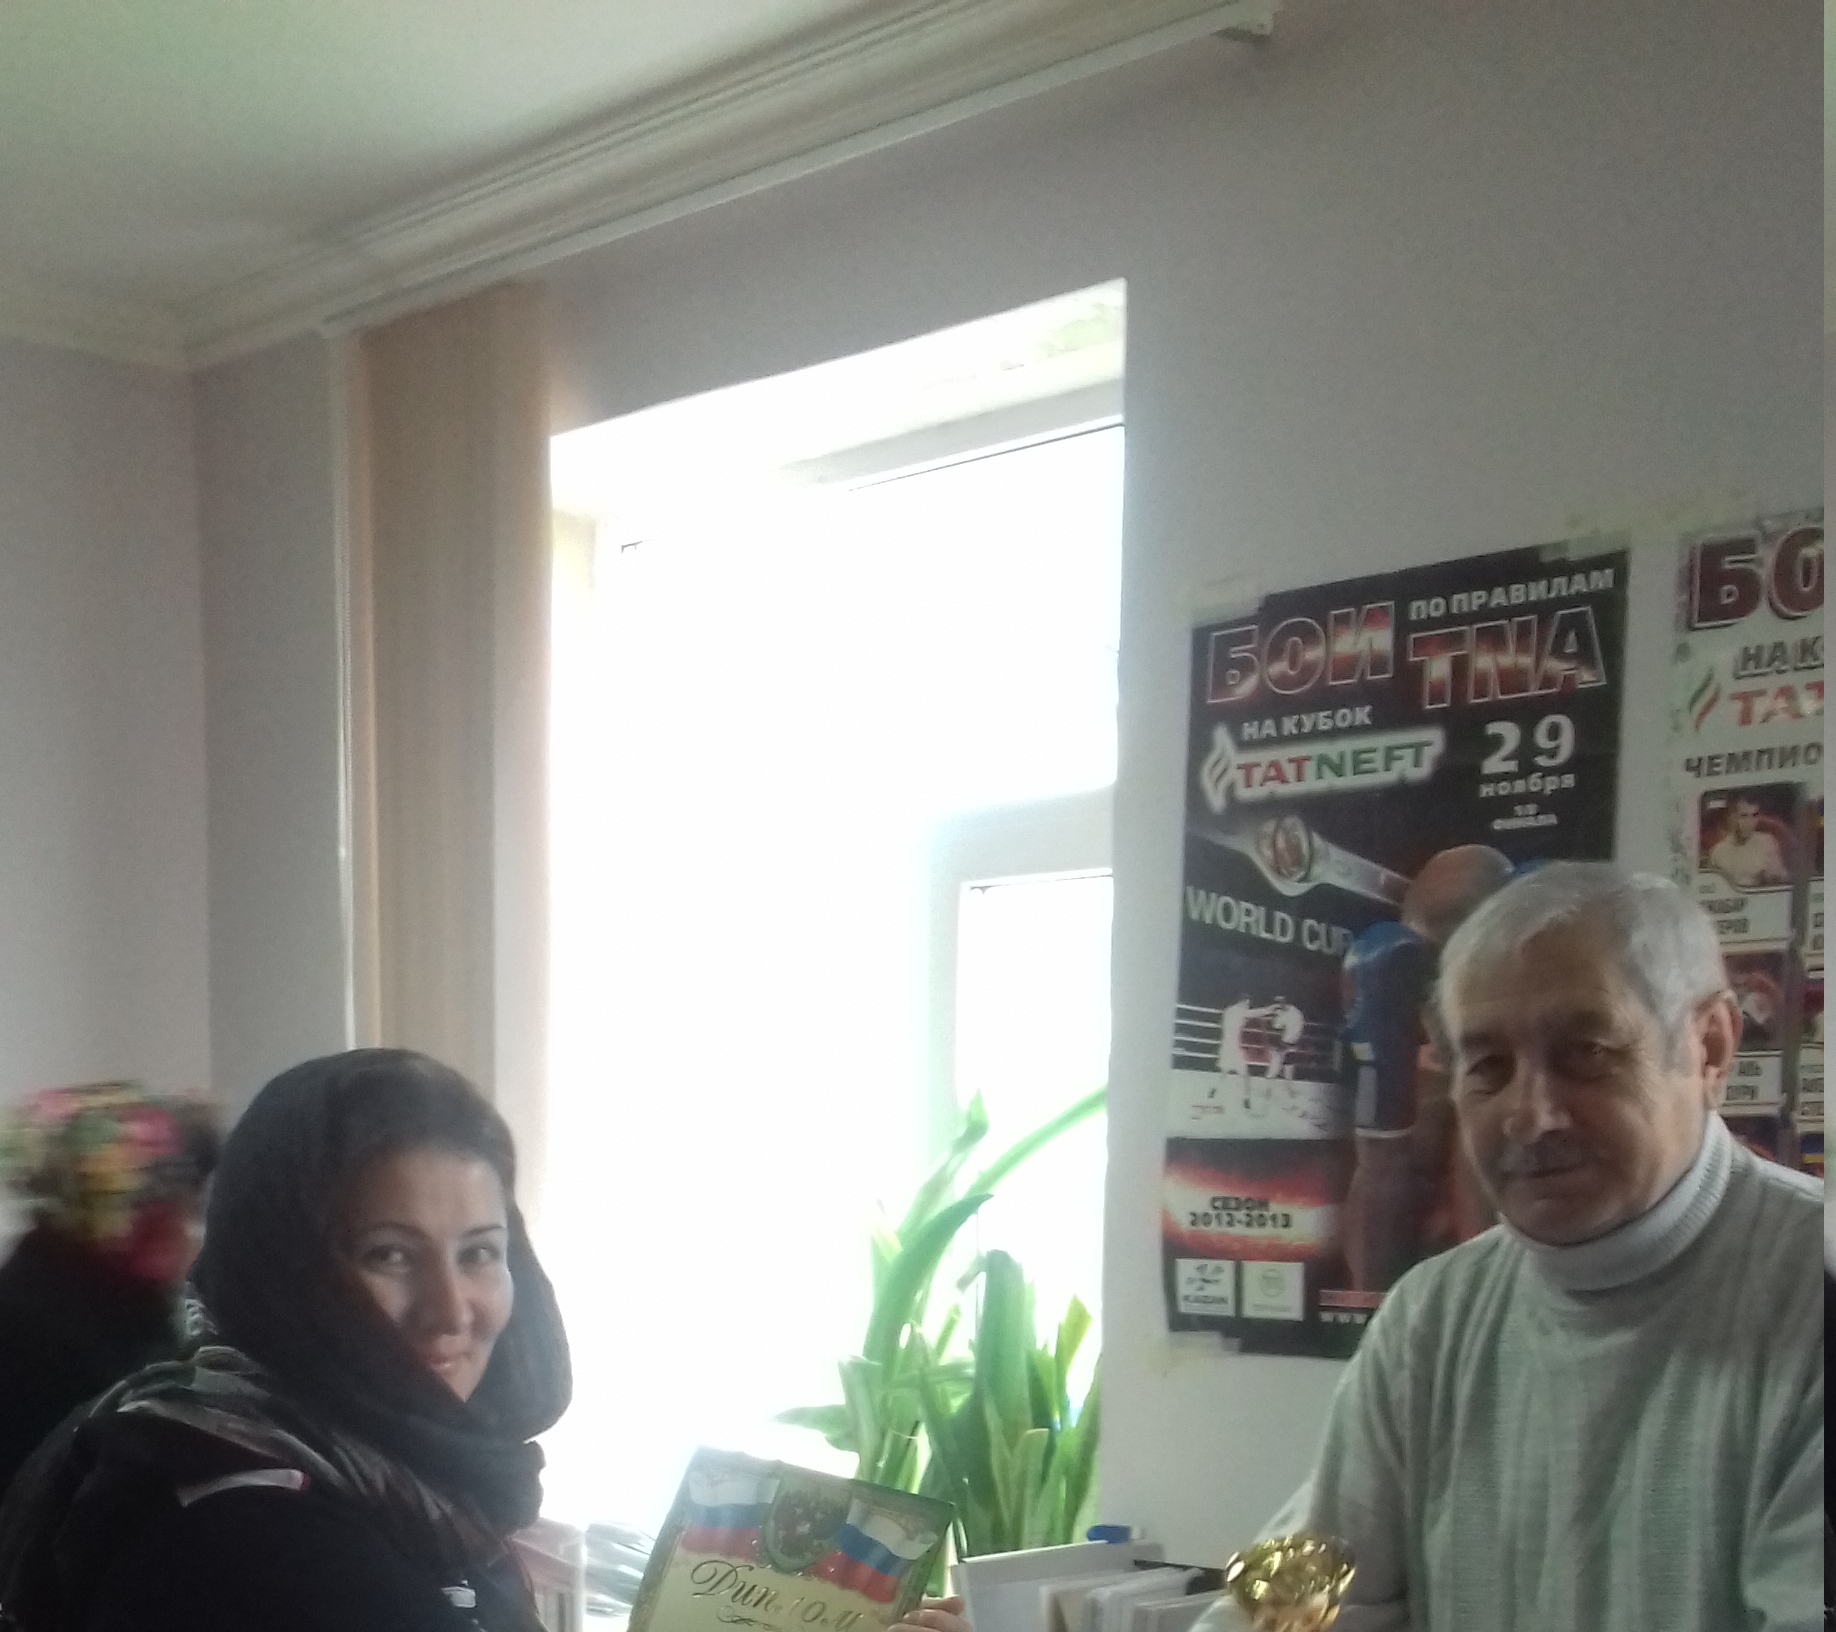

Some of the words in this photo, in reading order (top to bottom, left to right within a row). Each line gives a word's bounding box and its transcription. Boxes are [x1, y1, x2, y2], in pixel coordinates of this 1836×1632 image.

[1409, 597, 1448, 621] ПО
[1451, 568, 1615, 614] ПРАВИЛАМ
[1206, 601, 1396, 704] БОИ
[1733, 640, 1792, 679] НА
[1242, 719, 1278, 740] НА
[1281, 704, 1374, 736] КУБОК
[1480, 713, 1576, 774] 29
[1237, 739, 1433, 789] TATNEFT
[1685, 742, 1824, 778] ЧЕМПИО
[1479, 771, 1576, 798] ноября
[1185, 885, 1295, 943] WORLD
[1210, 1196, 1271, 1212] СЕЗОН
